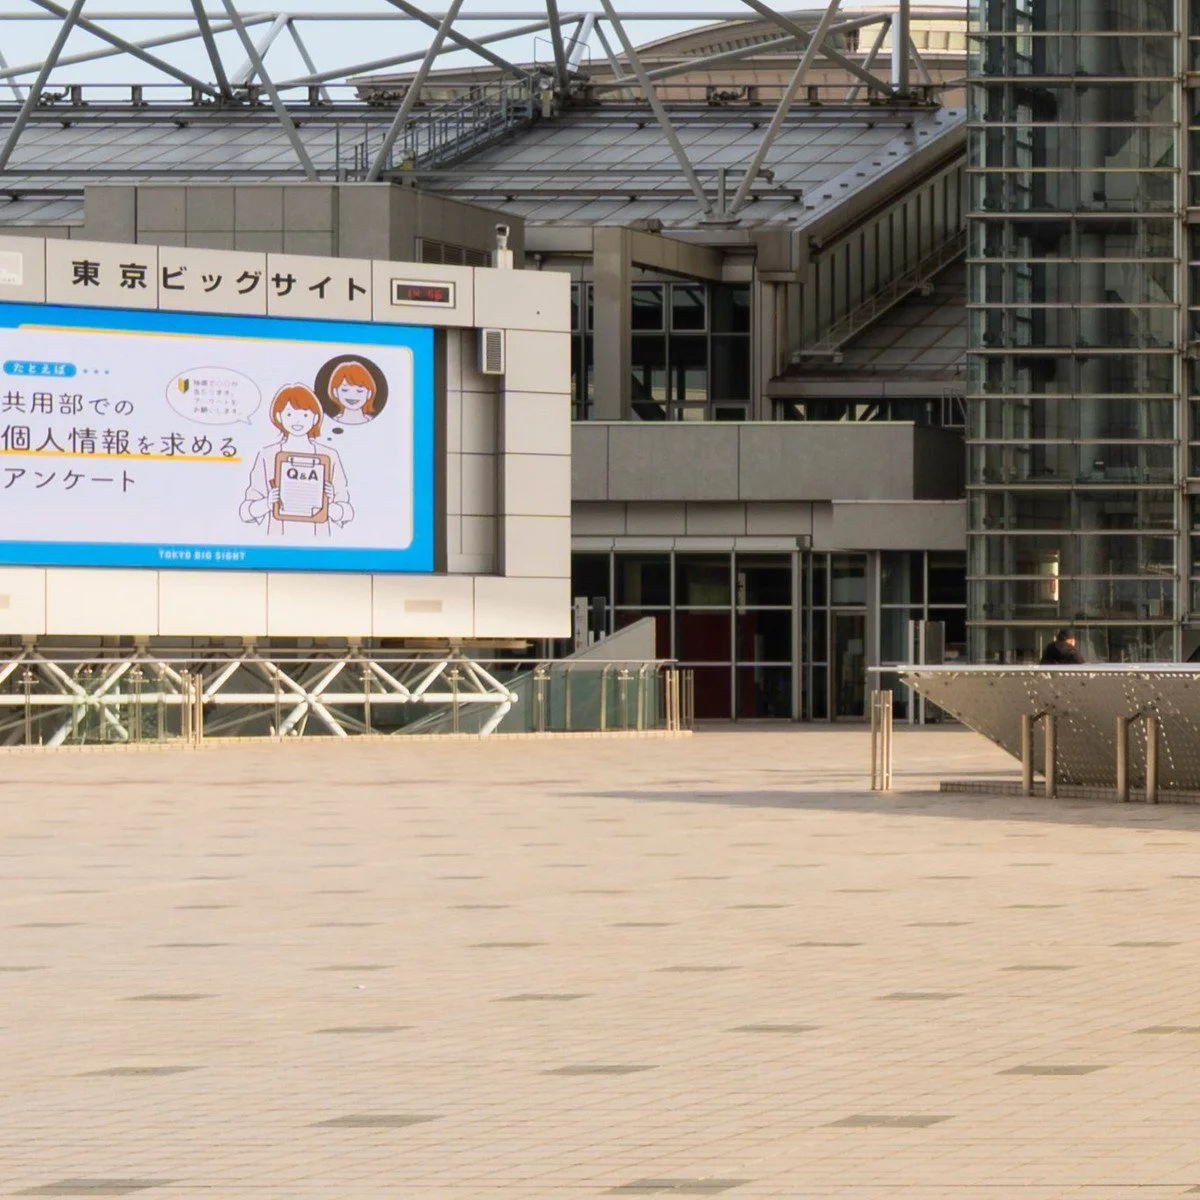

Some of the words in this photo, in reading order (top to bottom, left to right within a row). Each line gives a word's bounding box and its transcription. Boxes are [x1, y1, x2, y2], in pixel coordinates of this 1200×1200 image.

[71, 259, 367, 301] 東京ビッグサイト
[2, 390, 134, 416] 共用部での
[0, 424, 238, 457] 個人情報を求める
[4, 467, 135, 493] アンケート
[286, 467, 319, 481] Q&A
[158, 549, 191, 559] TOKYO
[194, 550, 212, 560] BIG
[215, 551, 246, 561] SIGHT
